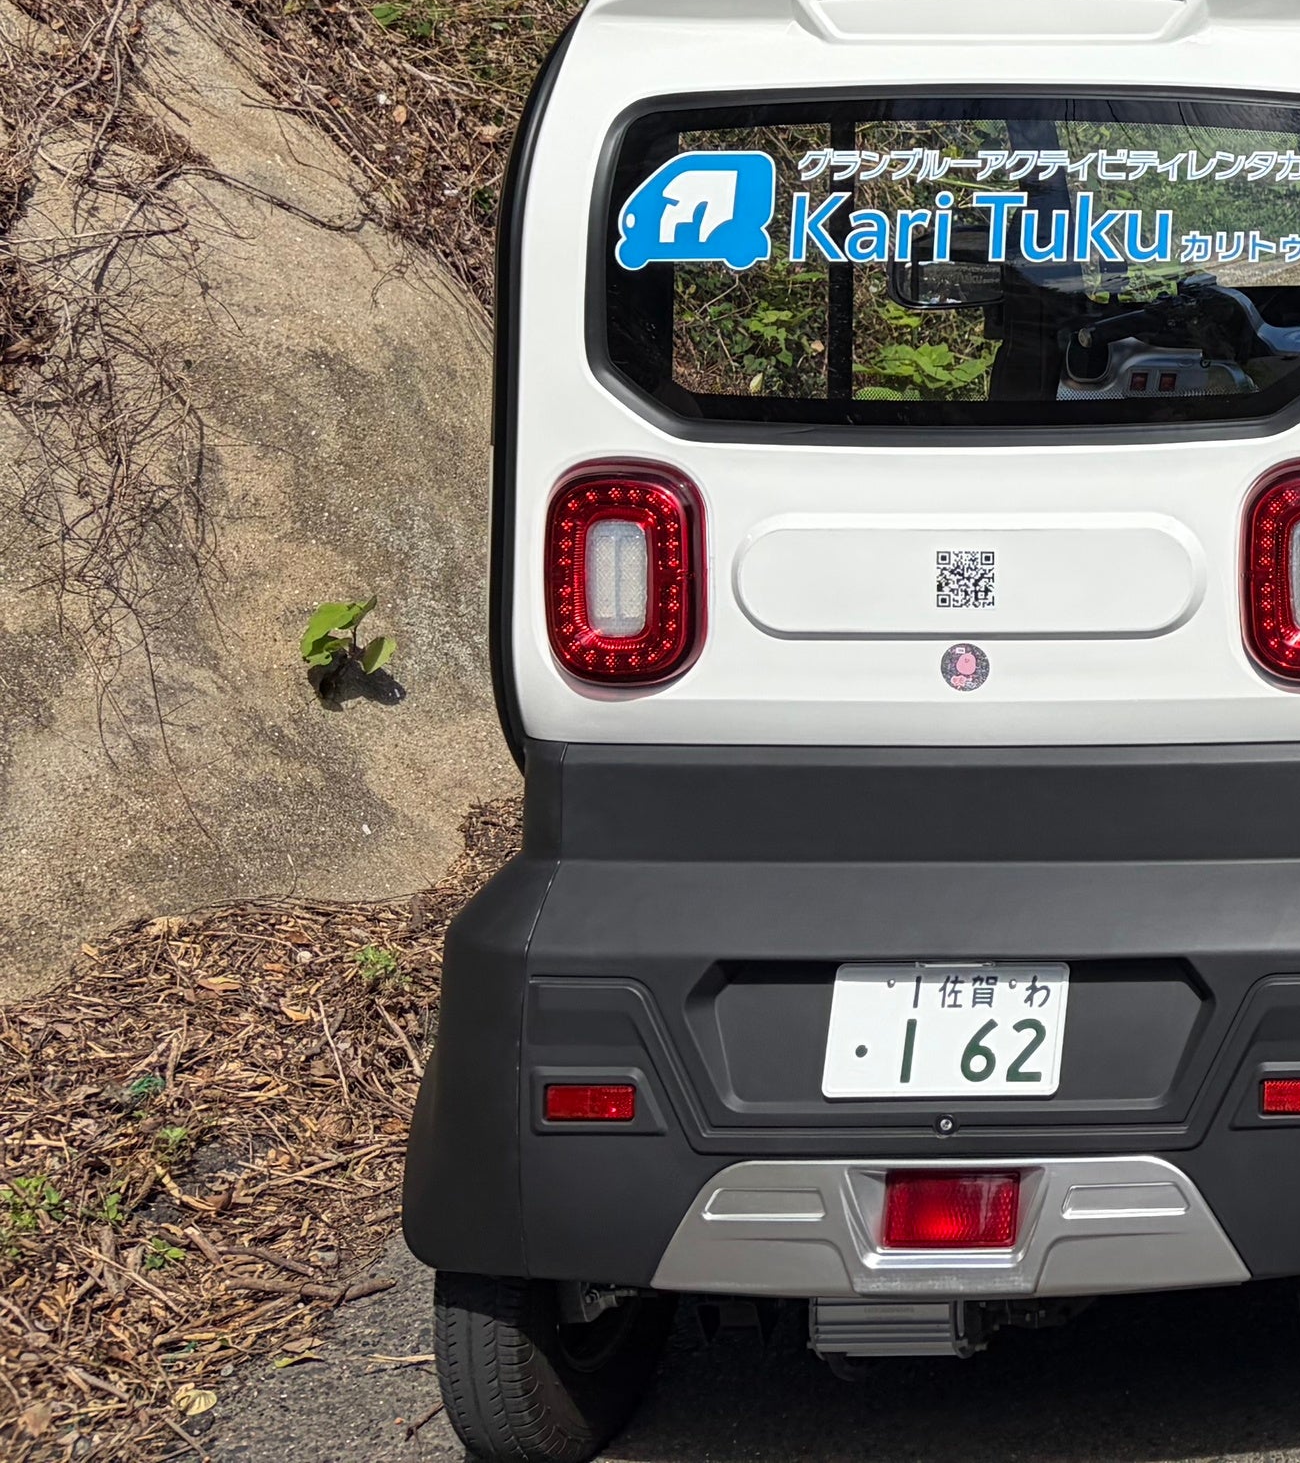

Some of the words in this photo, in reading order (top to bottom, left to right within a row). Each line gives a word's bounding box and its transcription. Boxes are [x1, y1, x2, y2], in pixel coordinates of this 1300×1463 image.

[789, 191, 954, 263] Kari
[973, 191, 1173, 263] Tuku
[938, 975, 999, 1008] 佐賀
[1023, 975, 1051, 1008] わ
